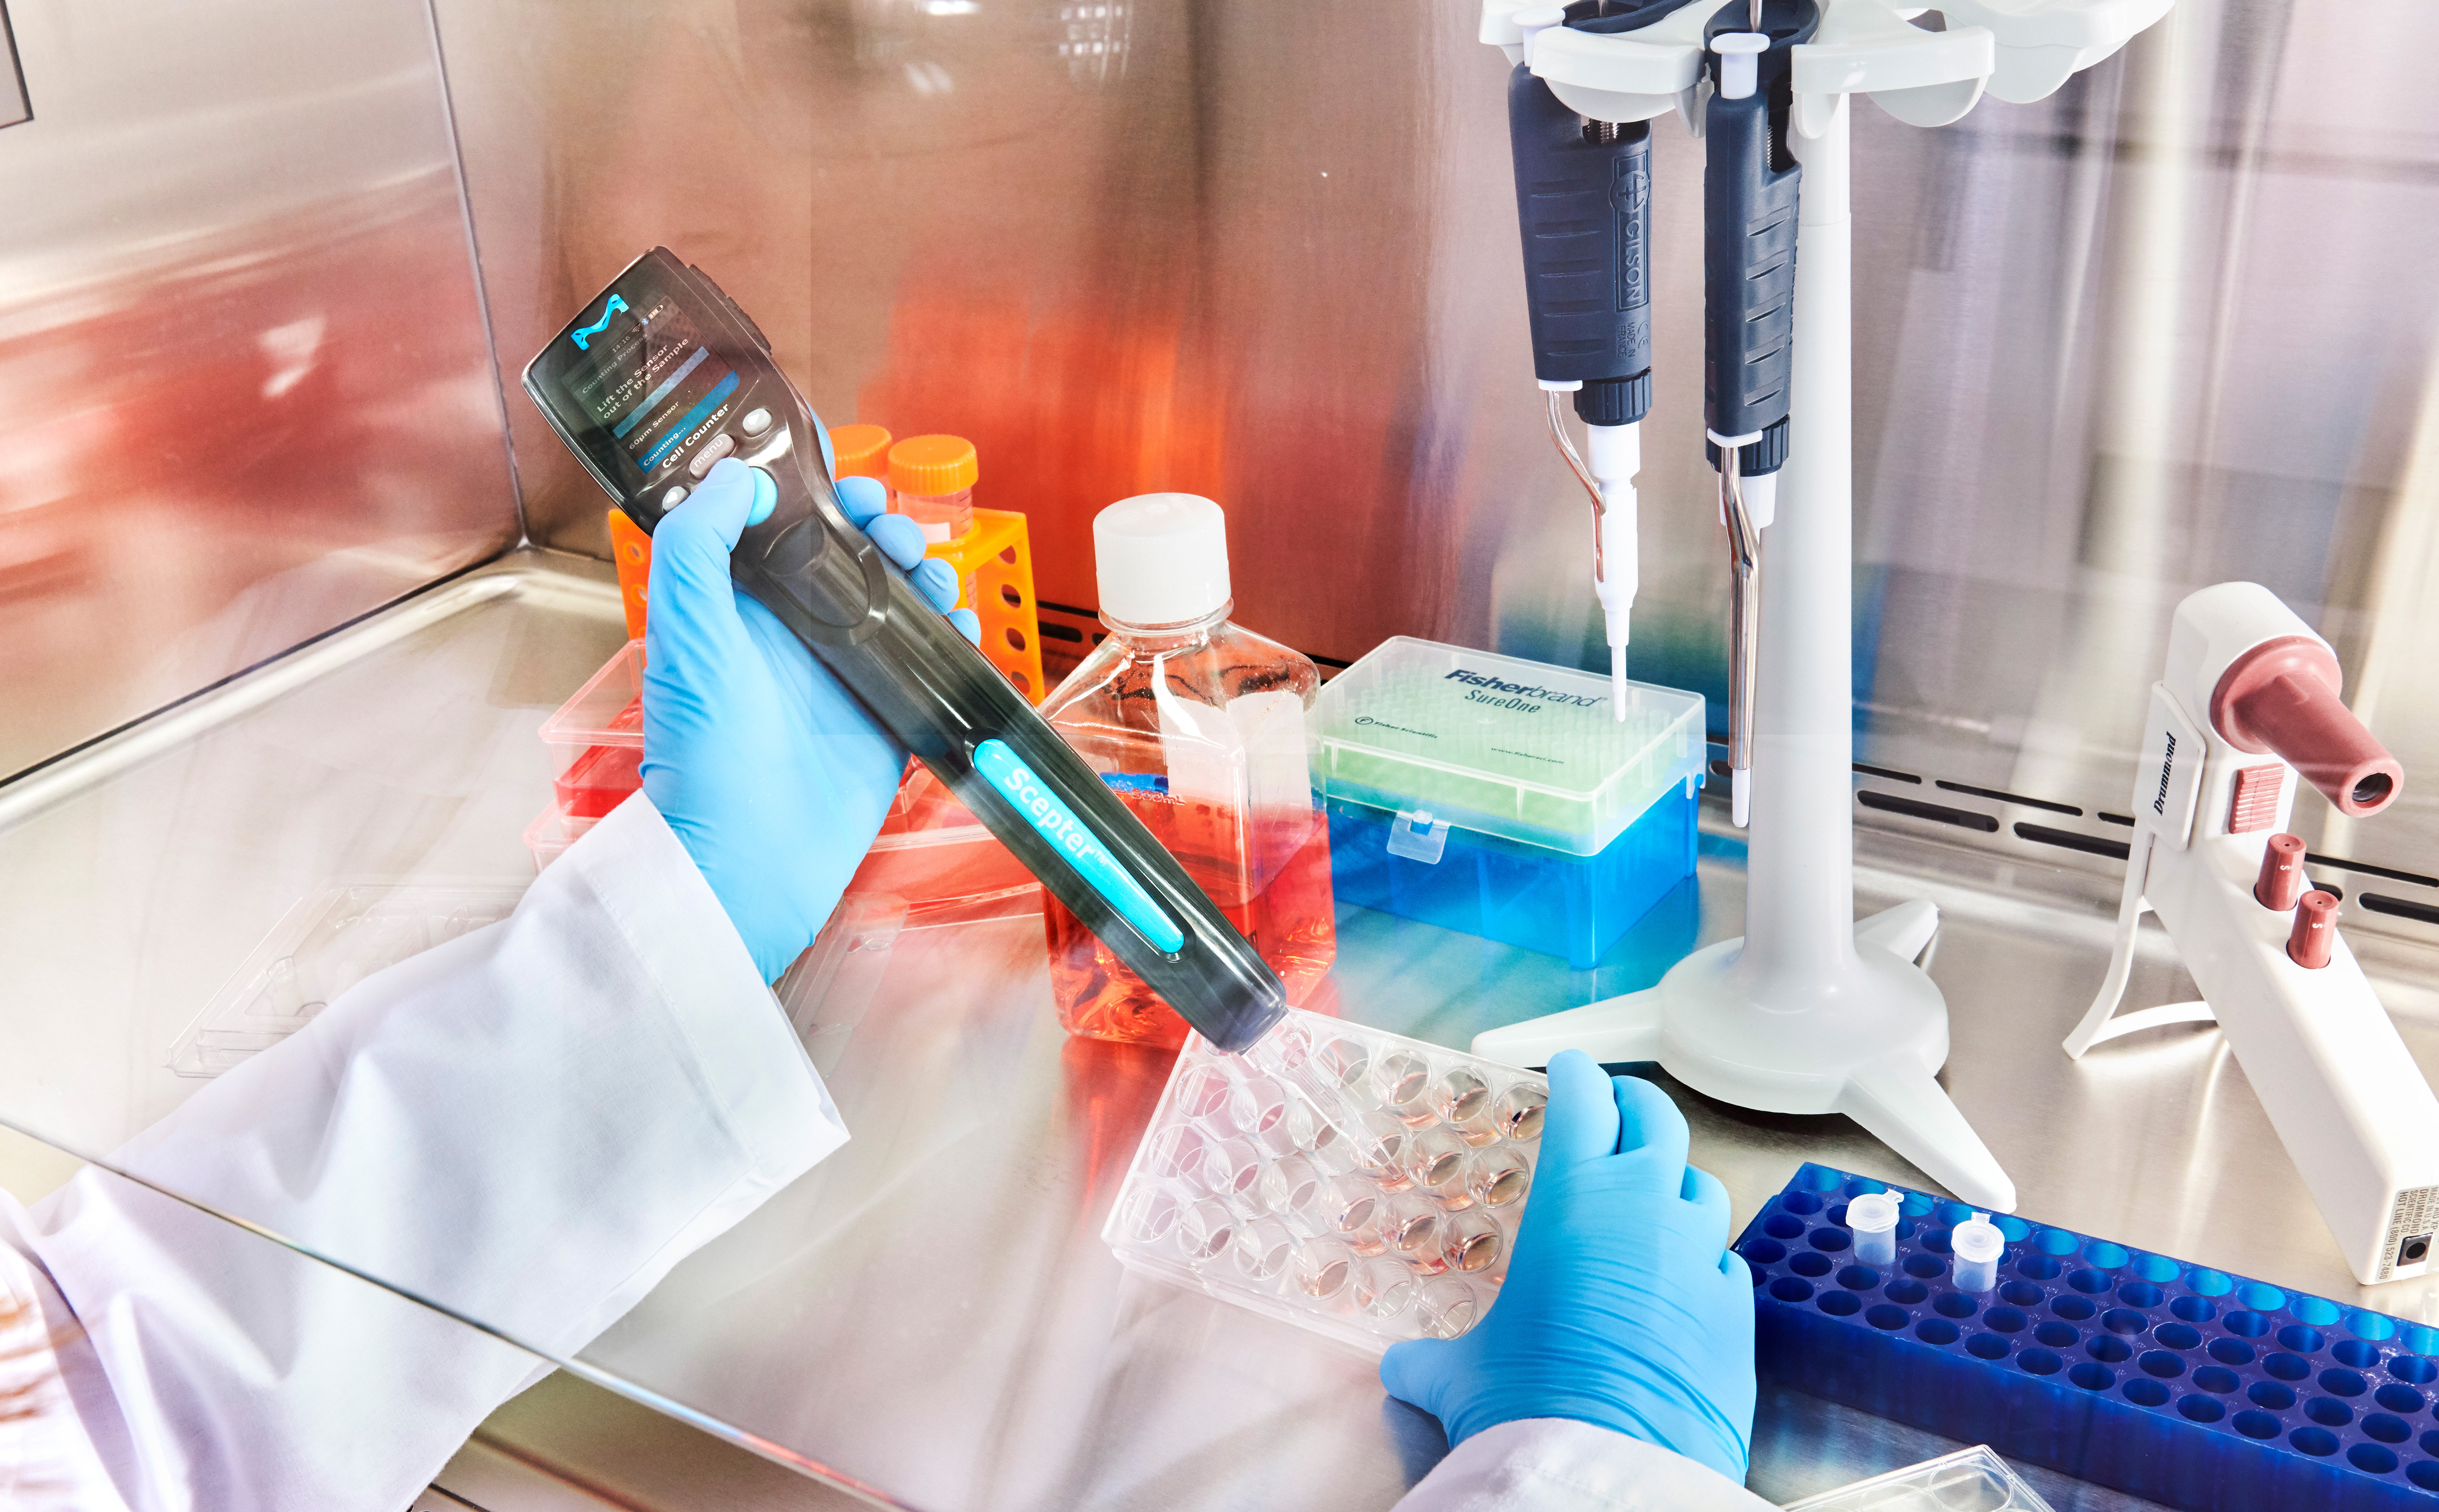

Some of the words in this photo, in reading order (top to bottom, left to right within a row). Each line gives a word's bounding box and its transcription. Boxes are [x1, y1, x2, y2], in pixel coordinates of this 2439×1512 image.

[1625, 220, 1641, 303] GILSON
[612, 336, 630, 353] 14:16
[1617, 325, 1626, 358] FRANCE
[1627, 322, 1635, 345] MADE
[582, 361, 617, 394] Counting
[617, 333, 648, 361] Process
[597, 394, 616, 412] Lift
[616, 378, 633, 394] the
[634, 345, 668, 378] Sensor
[604, 401, 621, 419] out
[622, 388, 633, 402] of
[633, 373, 652, 390] the
[652, 338, 689, 373] Sample
[652, 401, 679, 428] Sensor
[643, 427, 686, 466] Counting...
[662, 446, 685, 468] Cell
[685, 403, 729, 446] Counter
[694, 439, 723, 468] menu
[1444, 669, 1603, 707] Fisherbrand
[1465, 690, 1541, 713] SureOne
[1375, 721, 1399, 730] Fisher
[2154, 731, 2176, 816] Drummond
[1387, 1040, 1395, 1050] 4
[1447, 1056, 1456, 1066] 5
[1508, 1072, 1517, 1083] 6
[2397, 1191, 2409, 1206] HOT
[2403, 1190, 2419, 1223] SCIENTIFIC
[2428, 1187, 2438, 1203] MADE
[2392, 1208, 2404, 1225] LINE
[2410, 1189, 2429, 1233] DRUMMOND
[2430, 1220, 2439, 1230] XP
[2386, 1227, 2400, 1245] (800)
[2379, 1247, 2395, 1279] 523-7480
